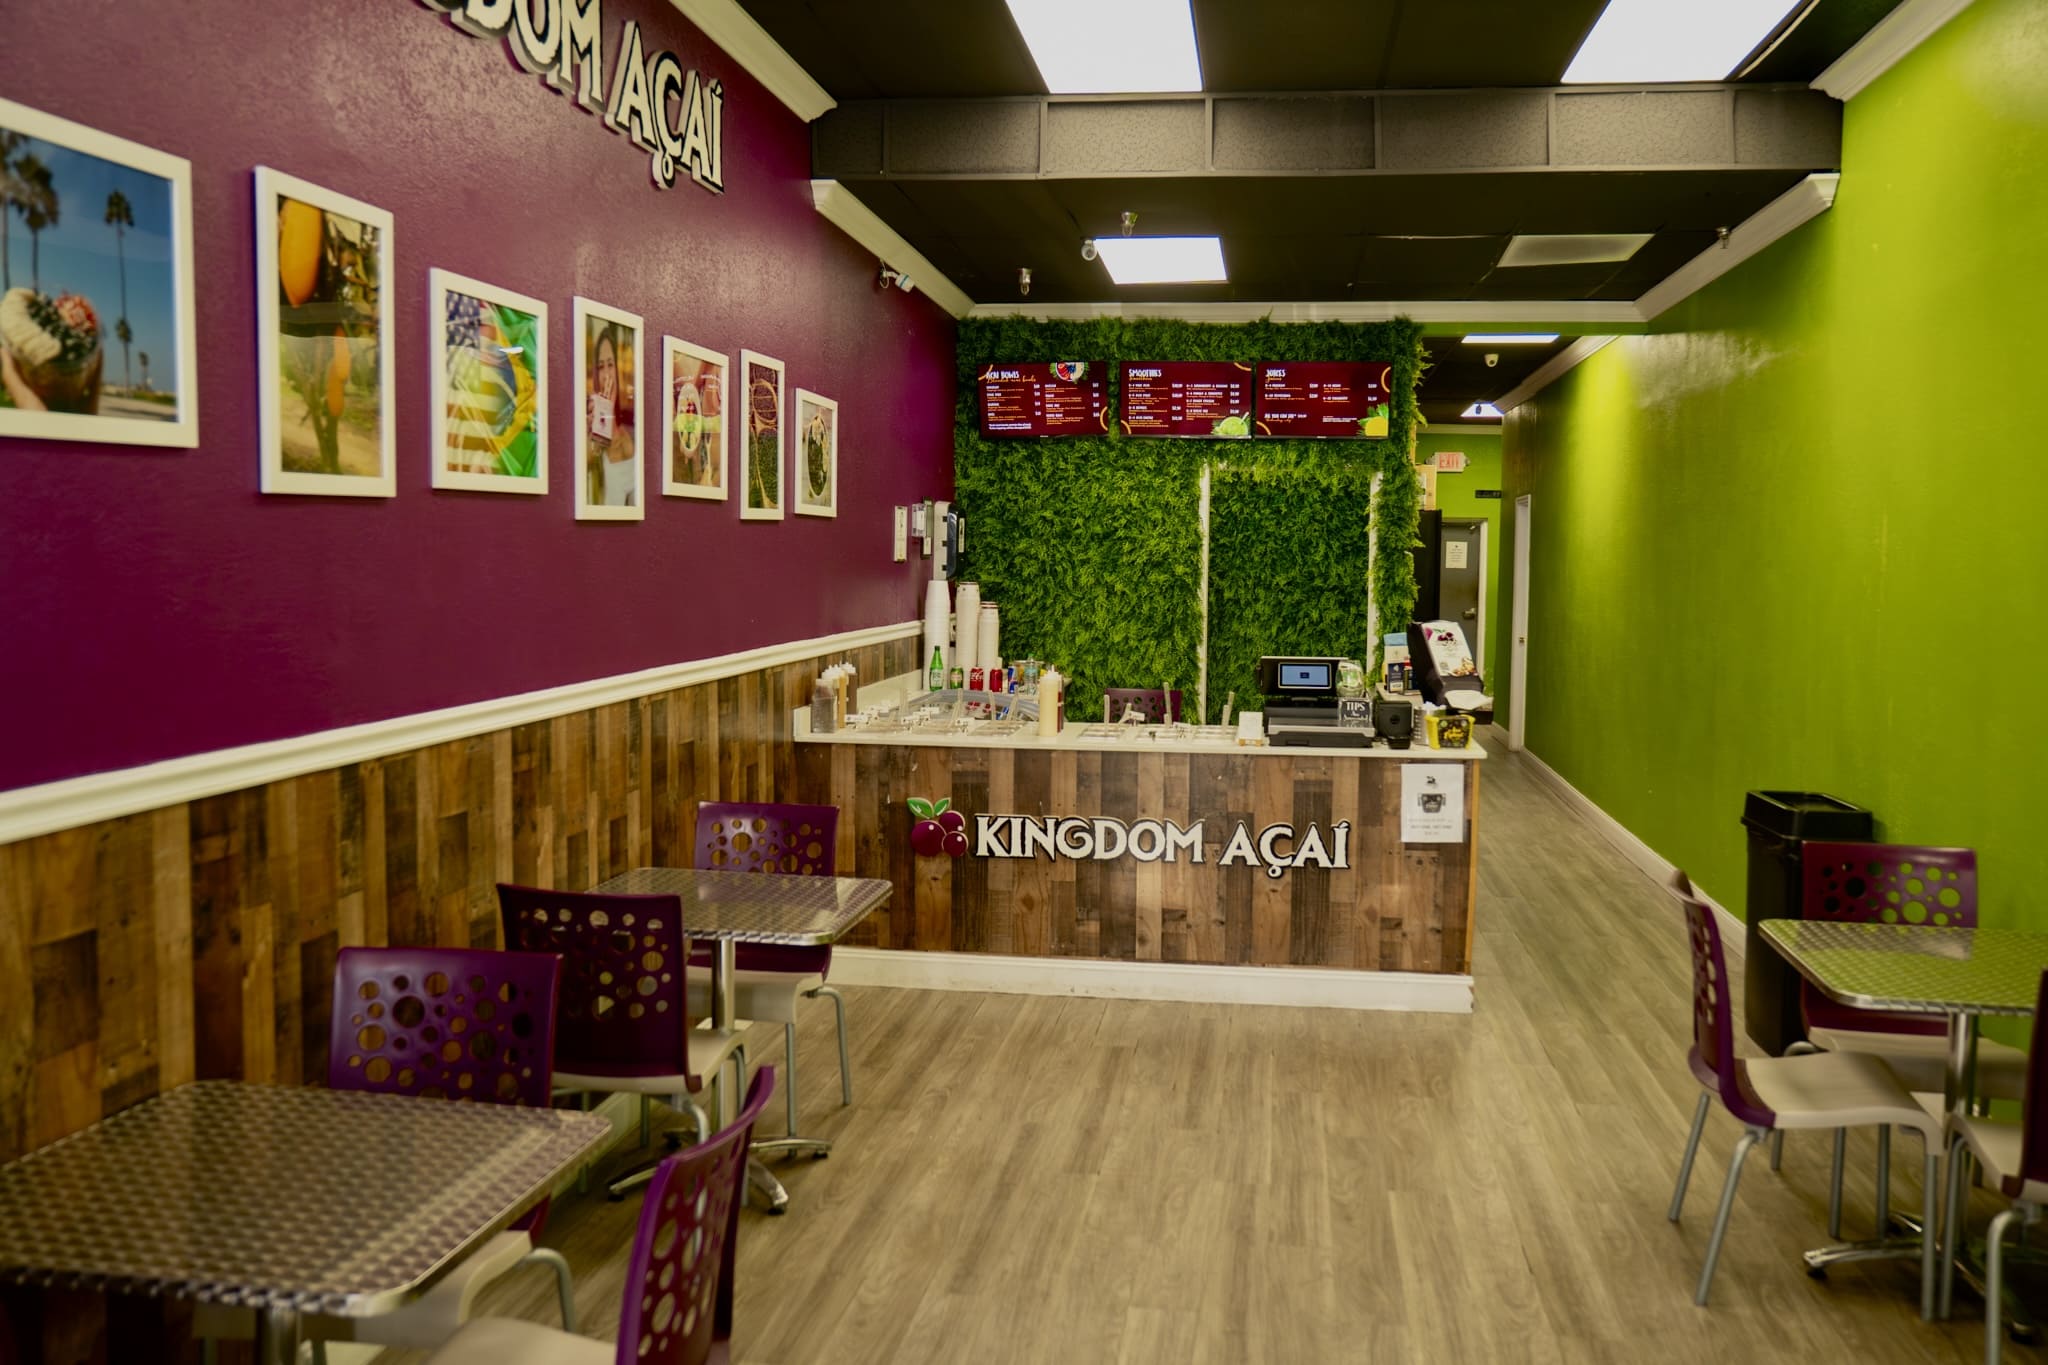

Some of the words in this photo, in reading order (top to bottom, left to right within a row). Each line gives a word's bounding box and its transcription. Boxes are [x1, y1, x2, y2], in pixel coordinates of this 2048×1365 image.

[604, 20, 724, 195] AÇAÍ
[1439, 453, 1460, 469] EXIT
[1346, 701, 1366, 711] TIPS
[973, 812, 1205, 864] KINGDOM
[1218, 819, 1351, 880] AÇAÍ
